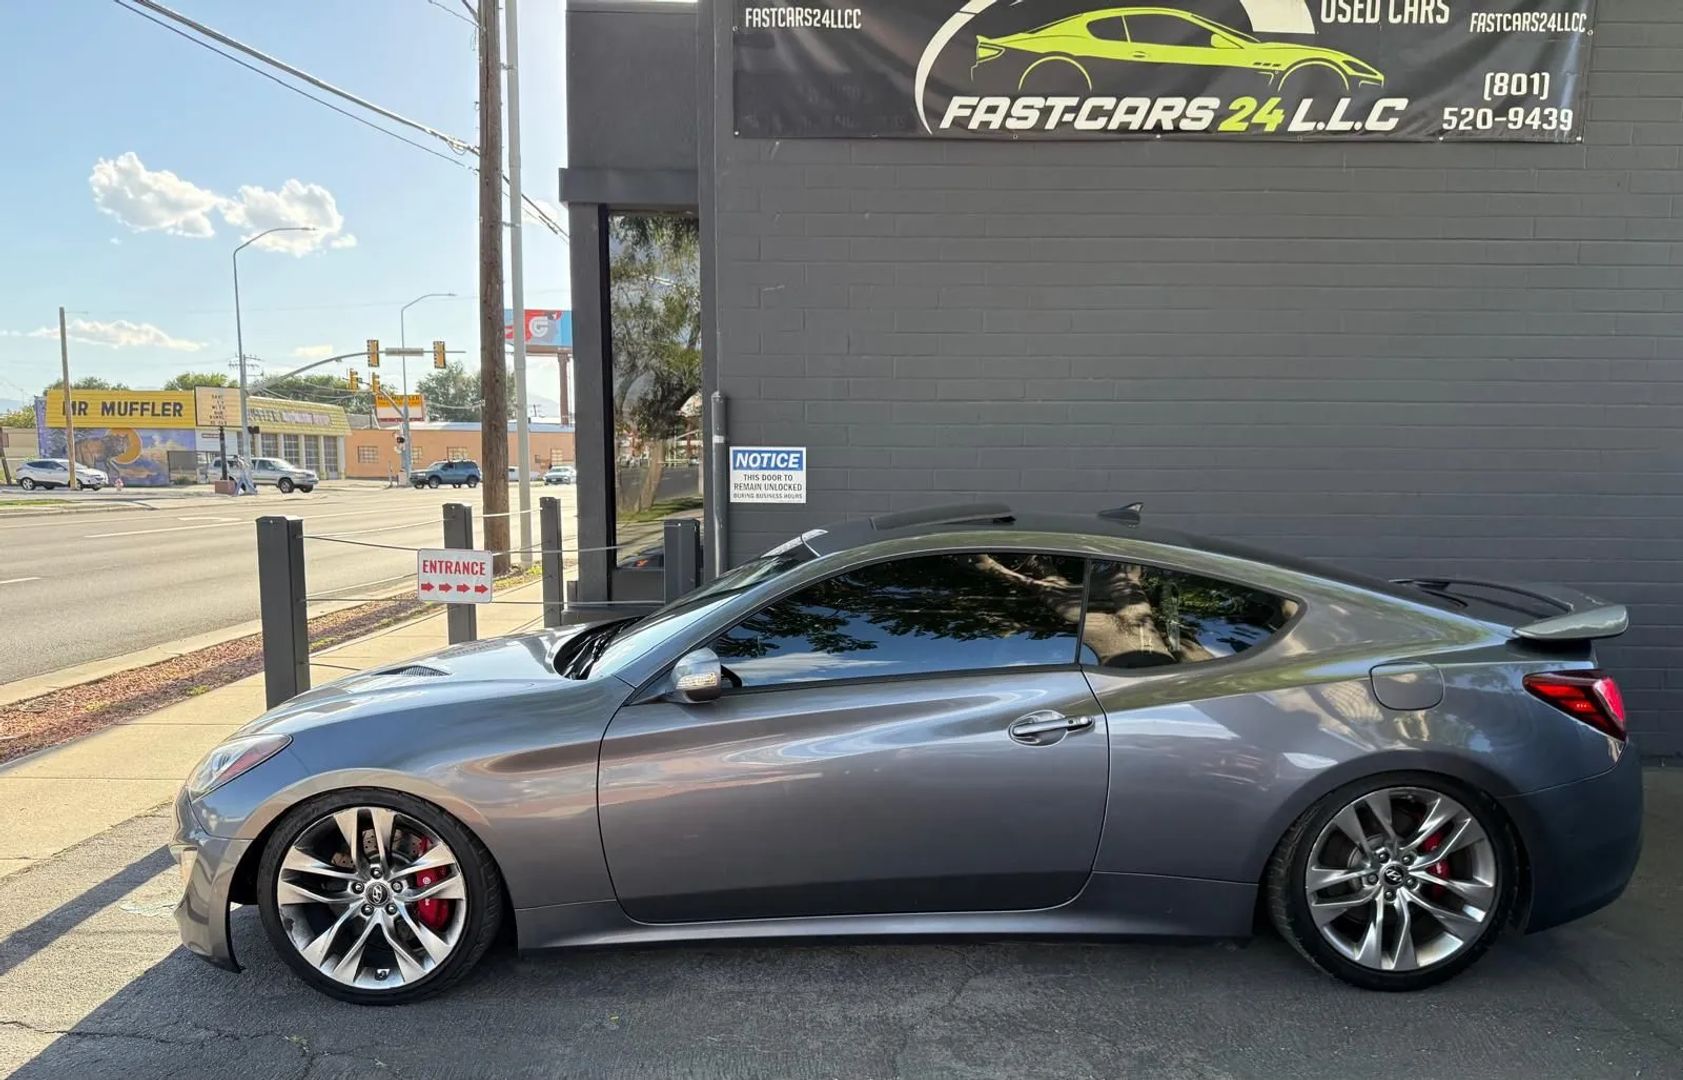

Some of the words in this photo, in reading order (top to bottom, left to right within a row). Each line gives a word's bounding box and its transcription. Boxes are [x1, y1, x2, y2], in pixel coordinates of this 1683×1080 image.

[745, 7, 862, 30] FASTCARS24LLCC
[1320, 0, 1381, 24] USED
[1388, 0, 1450, 25] CARS
[1483, 71, 1550, 101] (801)
[939, 96, 1220, 132] FAST-CARS
[1217, 97, 1285, 133] 24
[1287, 98, 1408, 132] L.L.C
[1442, 107, 1573, 132] 520-9439
[100, 401, 184, 418] MUFFLER
[735, 452, 801, 469] NOTICE
[733, 483, 762, 491] REMAIN
[764, 483, 802, 491] UNLOCKED
[761, 474, 782, 482] DOOR
[784, 474, 793, 482] TO
[422, 559, 486, 576] ENTRANCE
